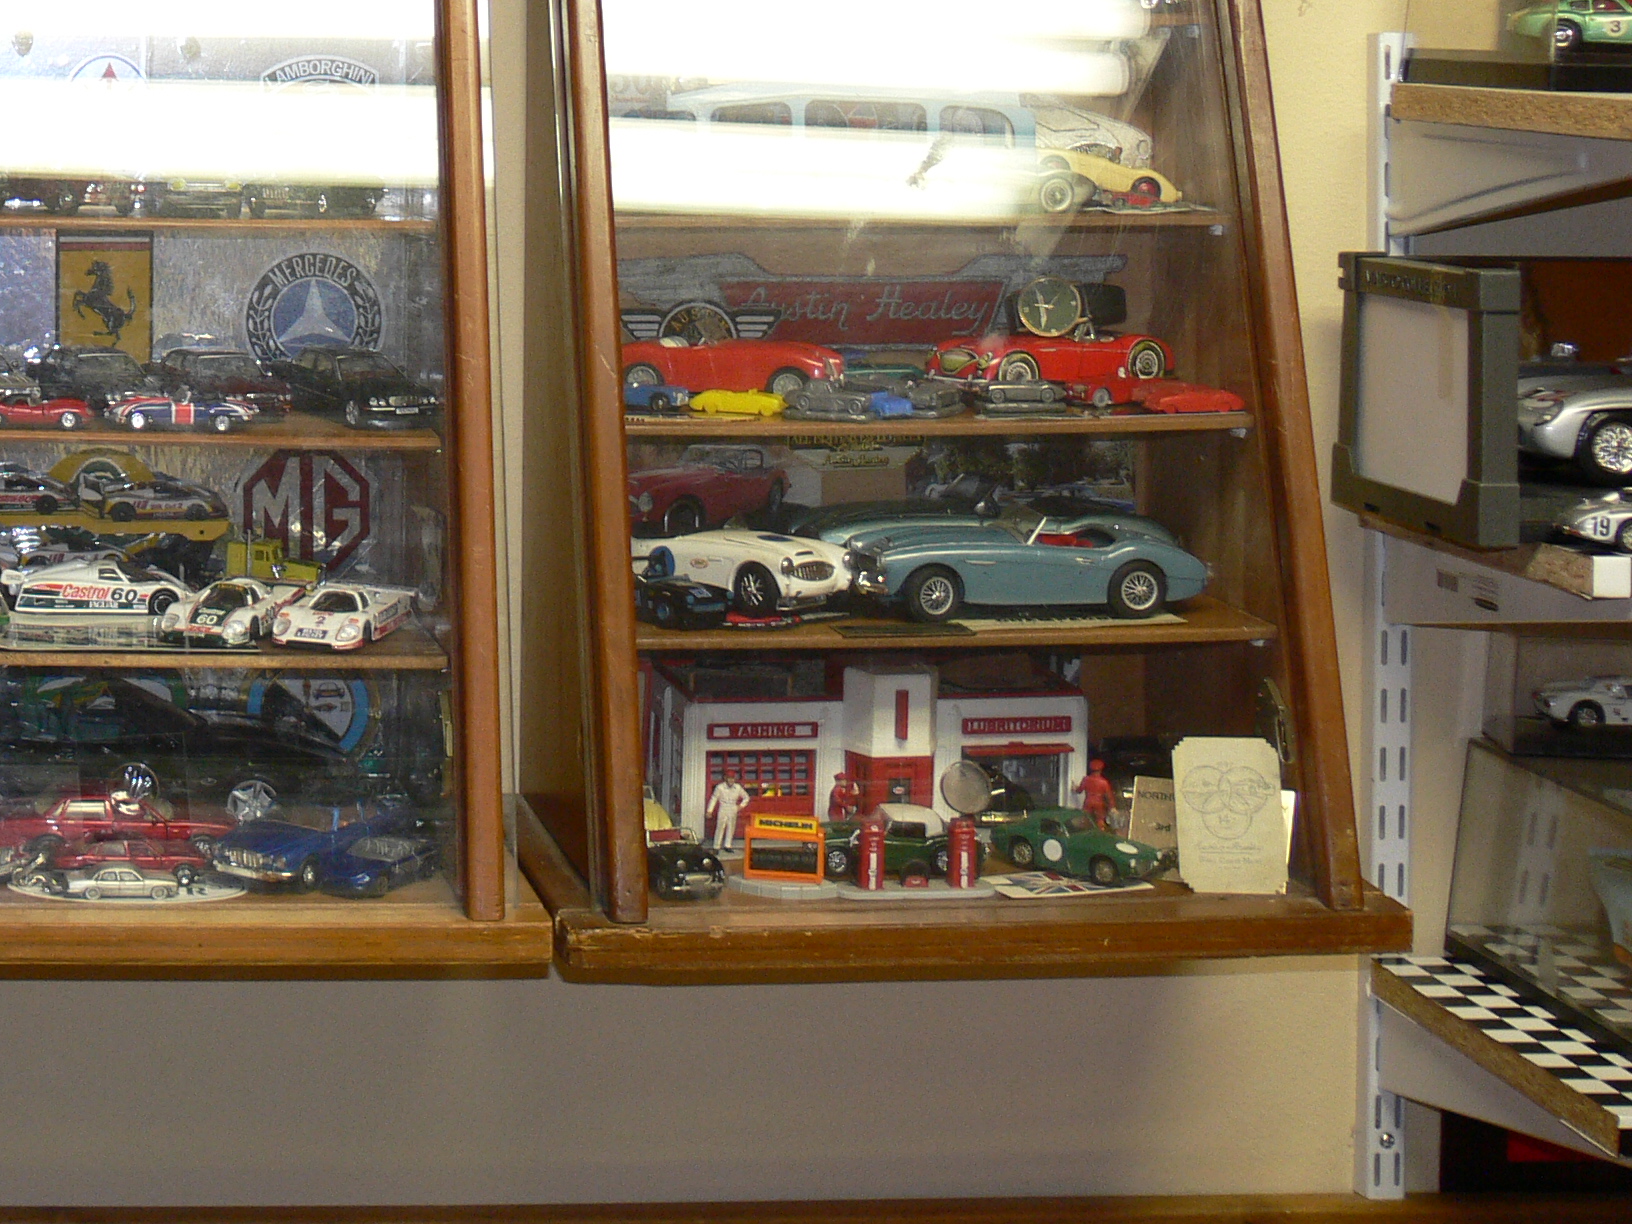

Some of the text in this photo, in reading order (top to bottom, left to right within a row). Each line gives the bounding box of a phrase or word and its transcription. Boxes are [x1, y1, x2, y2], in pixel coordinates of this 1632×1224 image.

[1609, 20, 1621, 33] 3
[264, 60, 374, 89] LAMBORGHINI
[267, 254, 358, 291] MERCEDES
[741, 285, 989, 336] Austin Healey
[251, 455, 361, 558] MG
[1591, 516, 1612, 537] 19
[61, 583, 138, 604] Castrol 60
[196, 614, 218, 625] 60
[759, 818, 814, 831] MICHELIN
